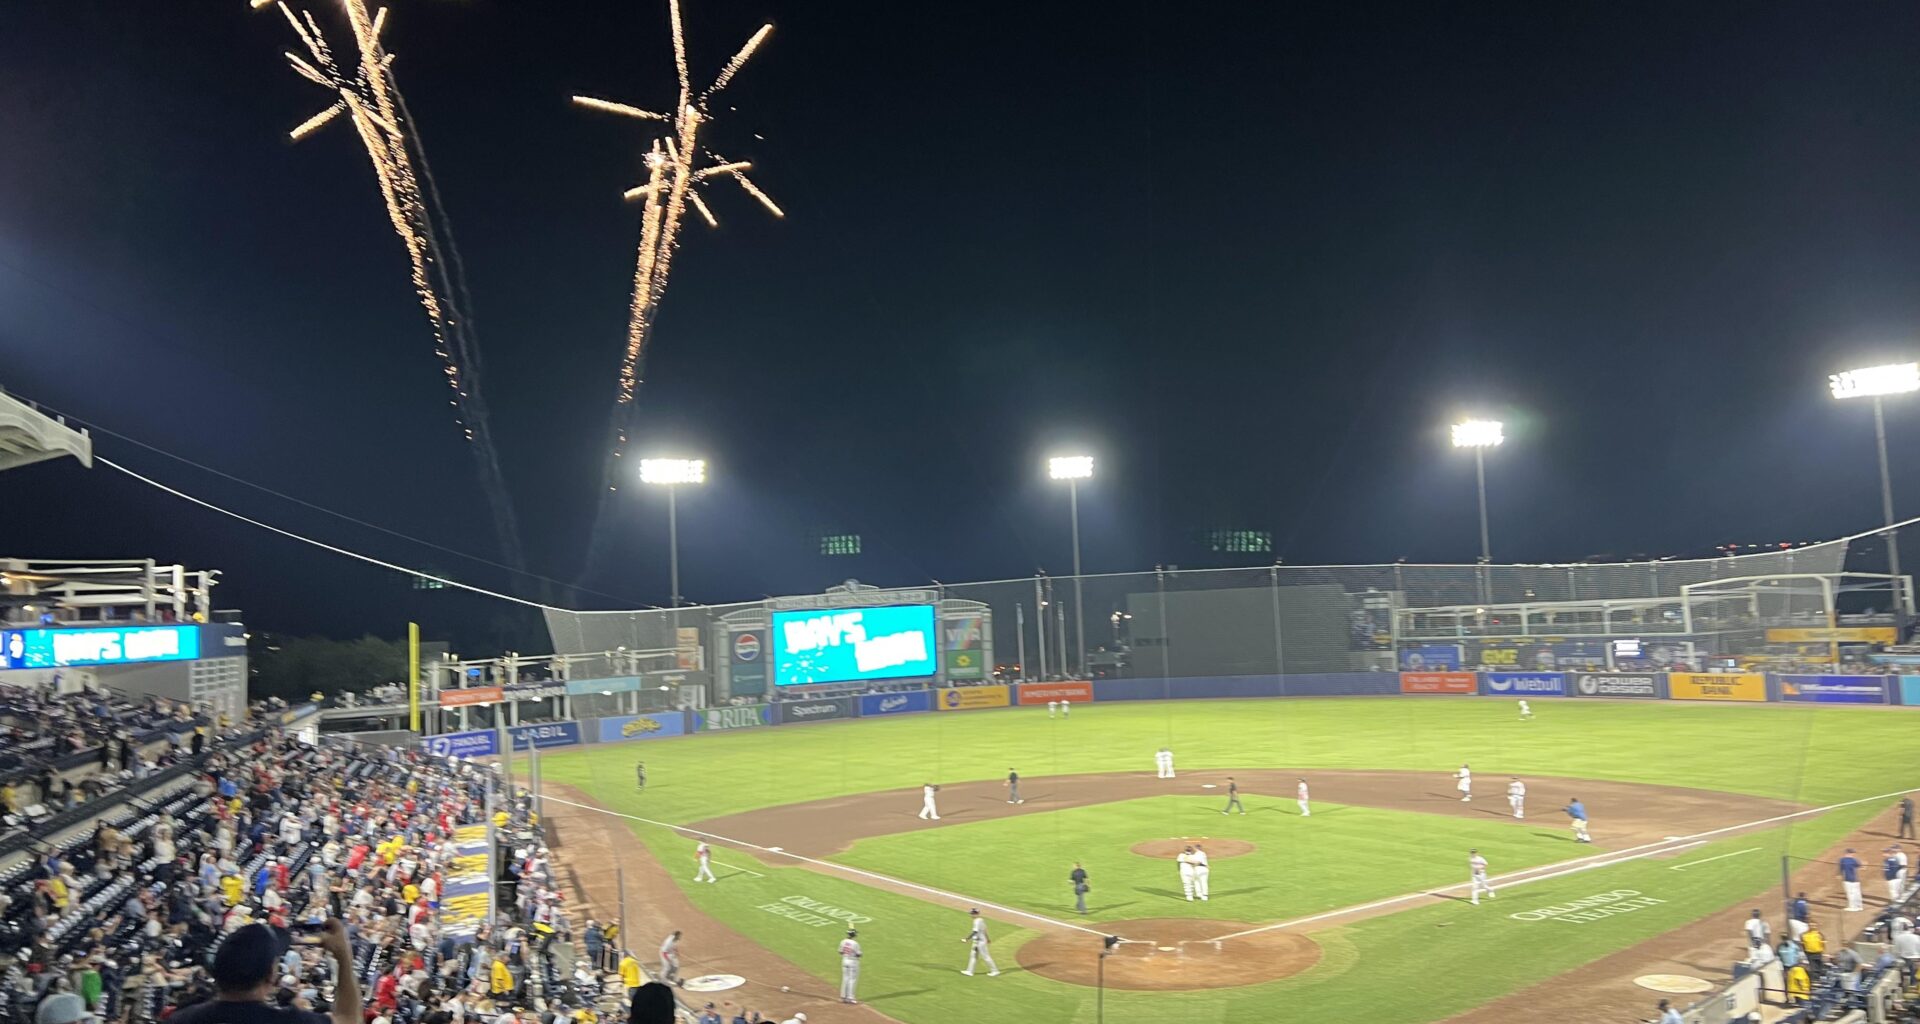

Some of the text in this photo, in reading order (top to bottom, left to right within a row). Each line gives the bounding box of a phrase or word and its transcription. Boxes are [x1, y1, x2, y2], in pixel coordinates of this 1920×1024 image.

[1512, 676, 1562, 692] Webull
[791, 704, 837, 717] Spectrum
[516, 726, 568, 741] JABIL
[755, 903, 838, 928] HEALTH
[780, 895, 872, 924] ORLANDO
[1509, 889, 1642, 921] ORLANDO
[1551, 897, 1668, 924] HEALTH
